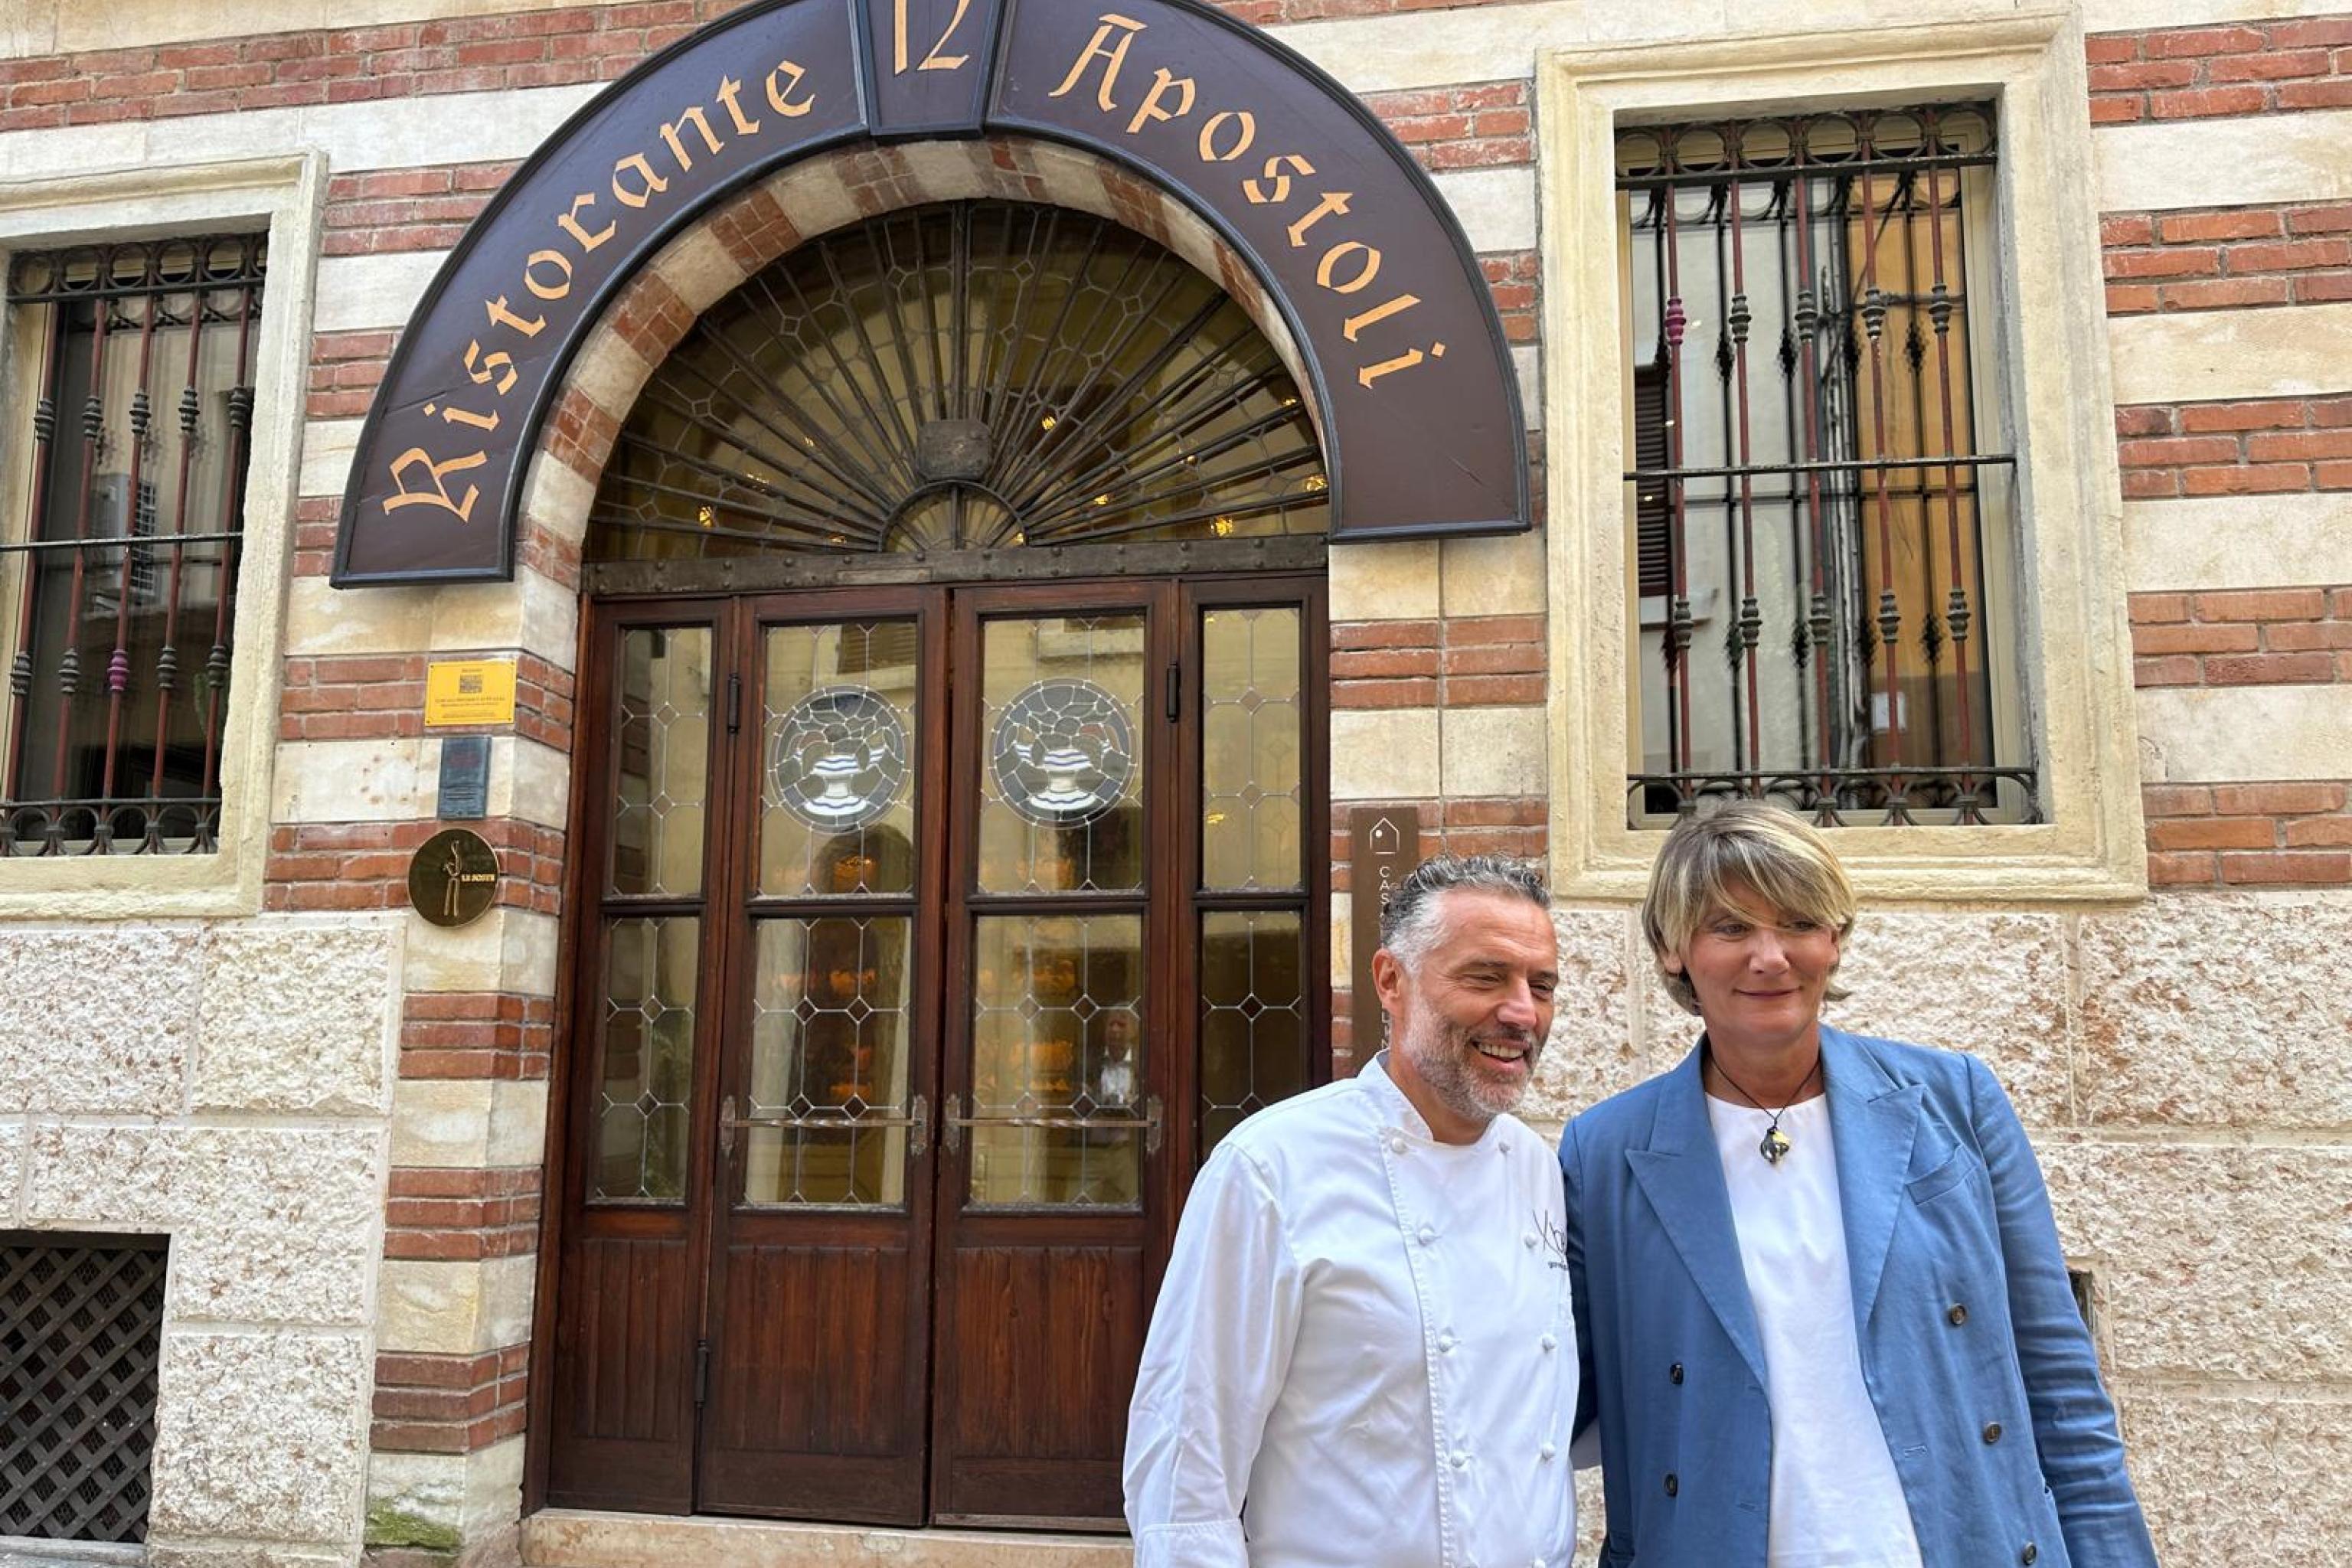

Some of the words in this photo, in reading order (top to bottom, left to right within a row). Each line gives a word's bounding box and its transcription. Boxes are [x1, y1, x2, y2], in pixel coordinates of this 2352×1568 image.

[383, 60, 815, 522] Ristorante
[894, 0, 971, 76] 12
[1048, 14, 1446, 390] Apostoli
